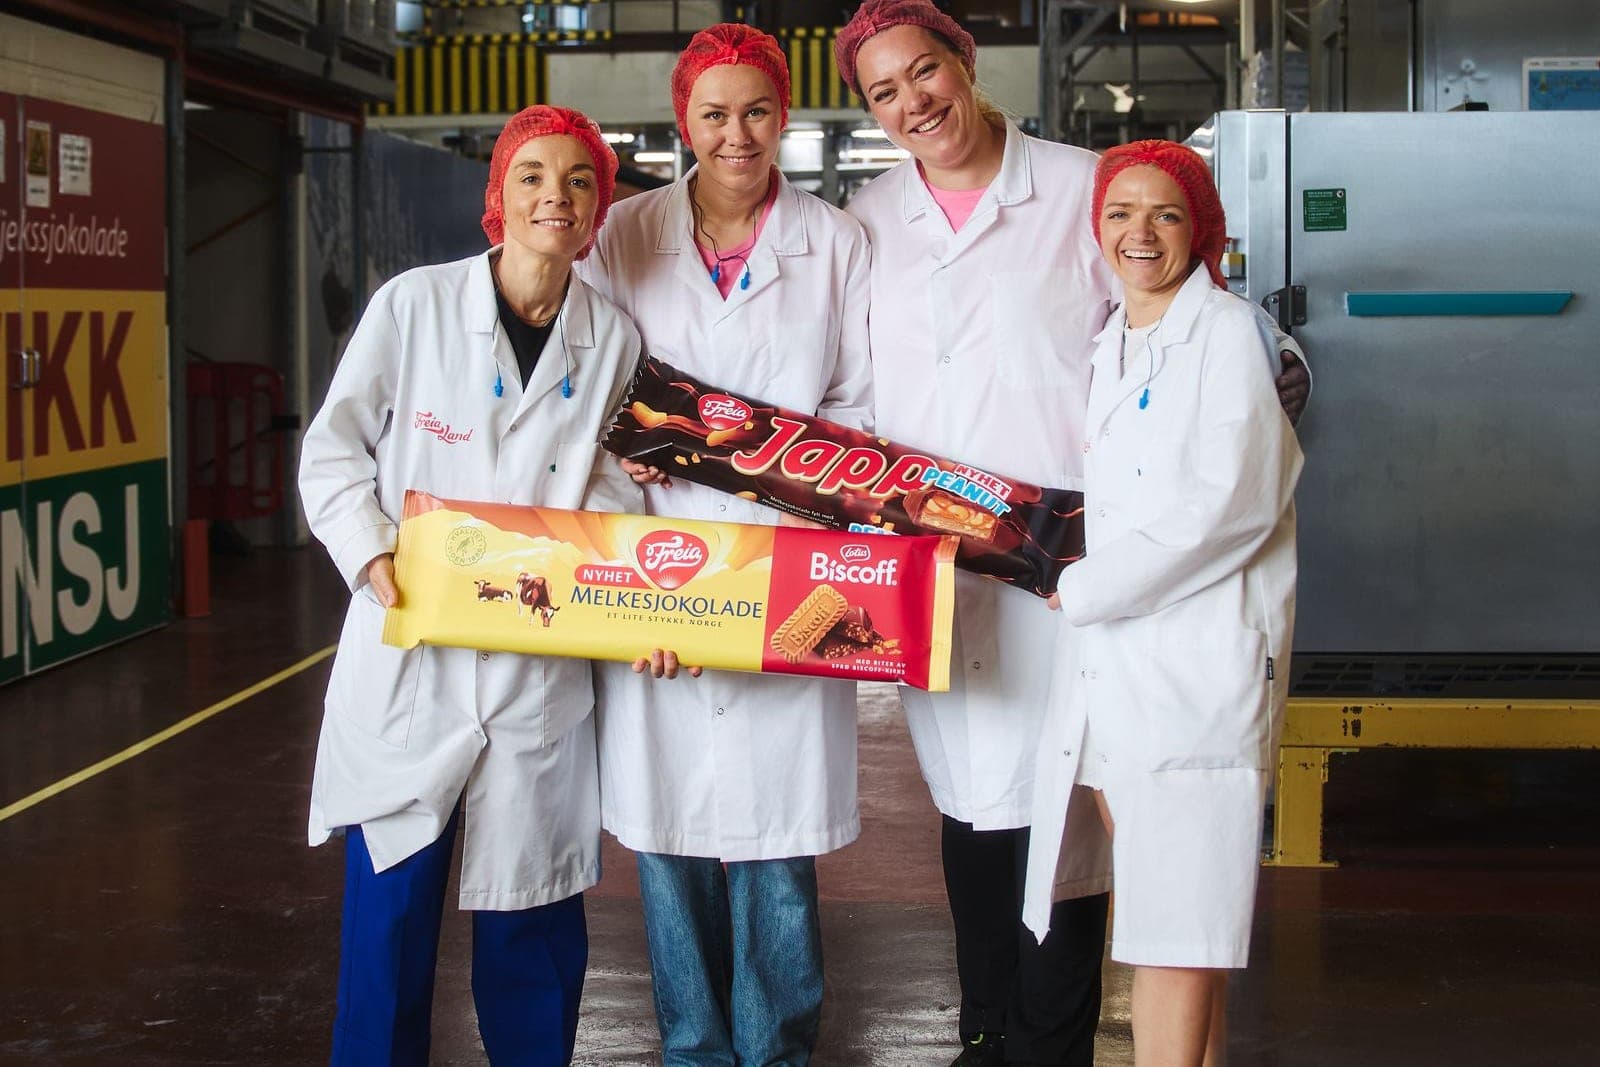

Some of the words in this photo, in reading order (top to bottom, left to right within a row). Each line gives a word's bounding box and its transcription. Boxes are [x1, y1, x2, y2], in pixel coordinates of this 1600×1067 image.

[705, 400, 747, 421] Freia
[415, 411, 443, 434] Freia
[438, 425, 473, 444] Land
[731, 417, 938, 498] Japp
[921, 467, 1011, 516] PEANUT
[956, 465, 1011, 499] NYHET
[645, 536, 703, 573] Freia
[845, 547, 869, 558] Lotus
[583, 568, 633, 584] NYHET
[570, 585, 763, 619] MELKESJOKOLADE
[623, 613, 643, 621] LITE
[648, 615, 684, 625] STYKKE
[689, 618, 723, 628] NORGE
[873, 659, 894, 667] BITER
